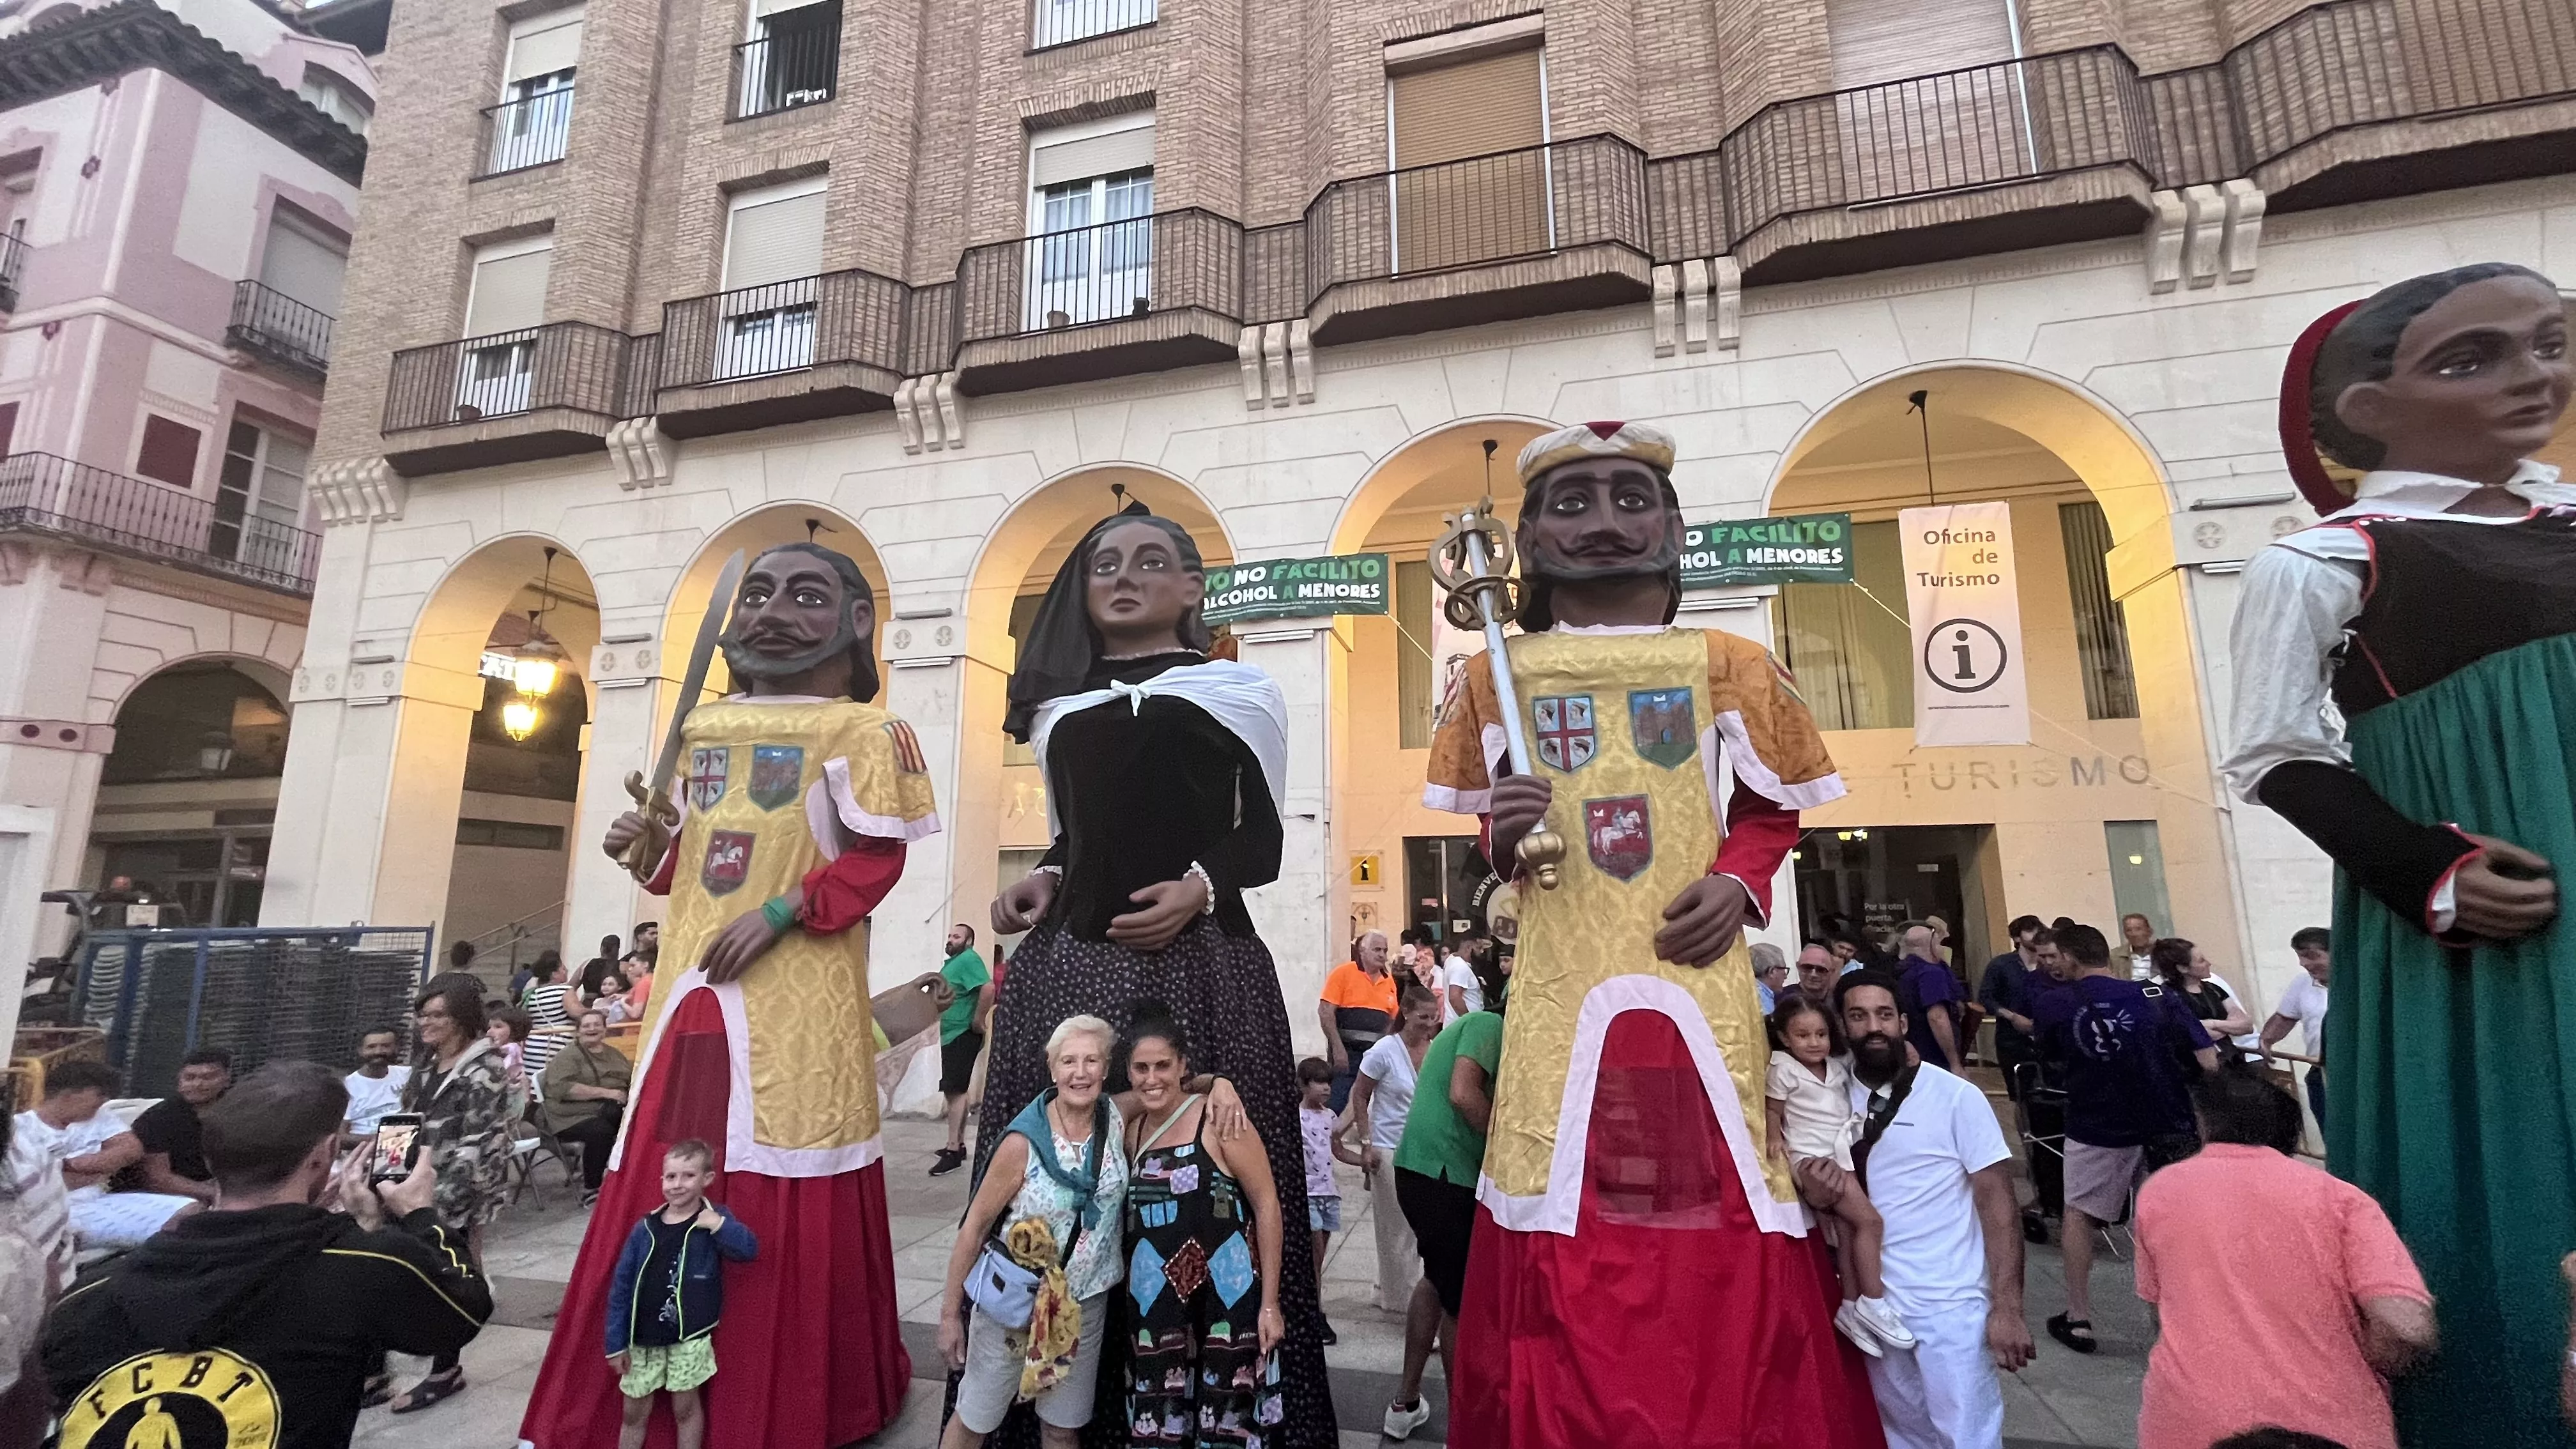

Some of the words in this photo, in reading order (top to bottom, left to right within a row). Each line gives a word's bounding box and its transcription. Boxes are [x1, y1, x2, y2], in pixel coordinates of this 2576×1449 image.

[1711, 520, 1841, 544] FACILITO
[1924, 528, 1996, 544] Oficina
[1727, 548, 1742, 564] A
[1746, 548, 1844, 564] MENORES
[1972, 548, 1998, 564] de
[1234, 566, 1267, 586] NO
[1272, 559, 1380, 579] FACILITO
[1917, 572, 2000, 587] Turismo
[1282, 585, 1294, 599] A
[1298, 583, 1381, 598] MENORES
[1892, 754, 2150, 792] TURISMO
